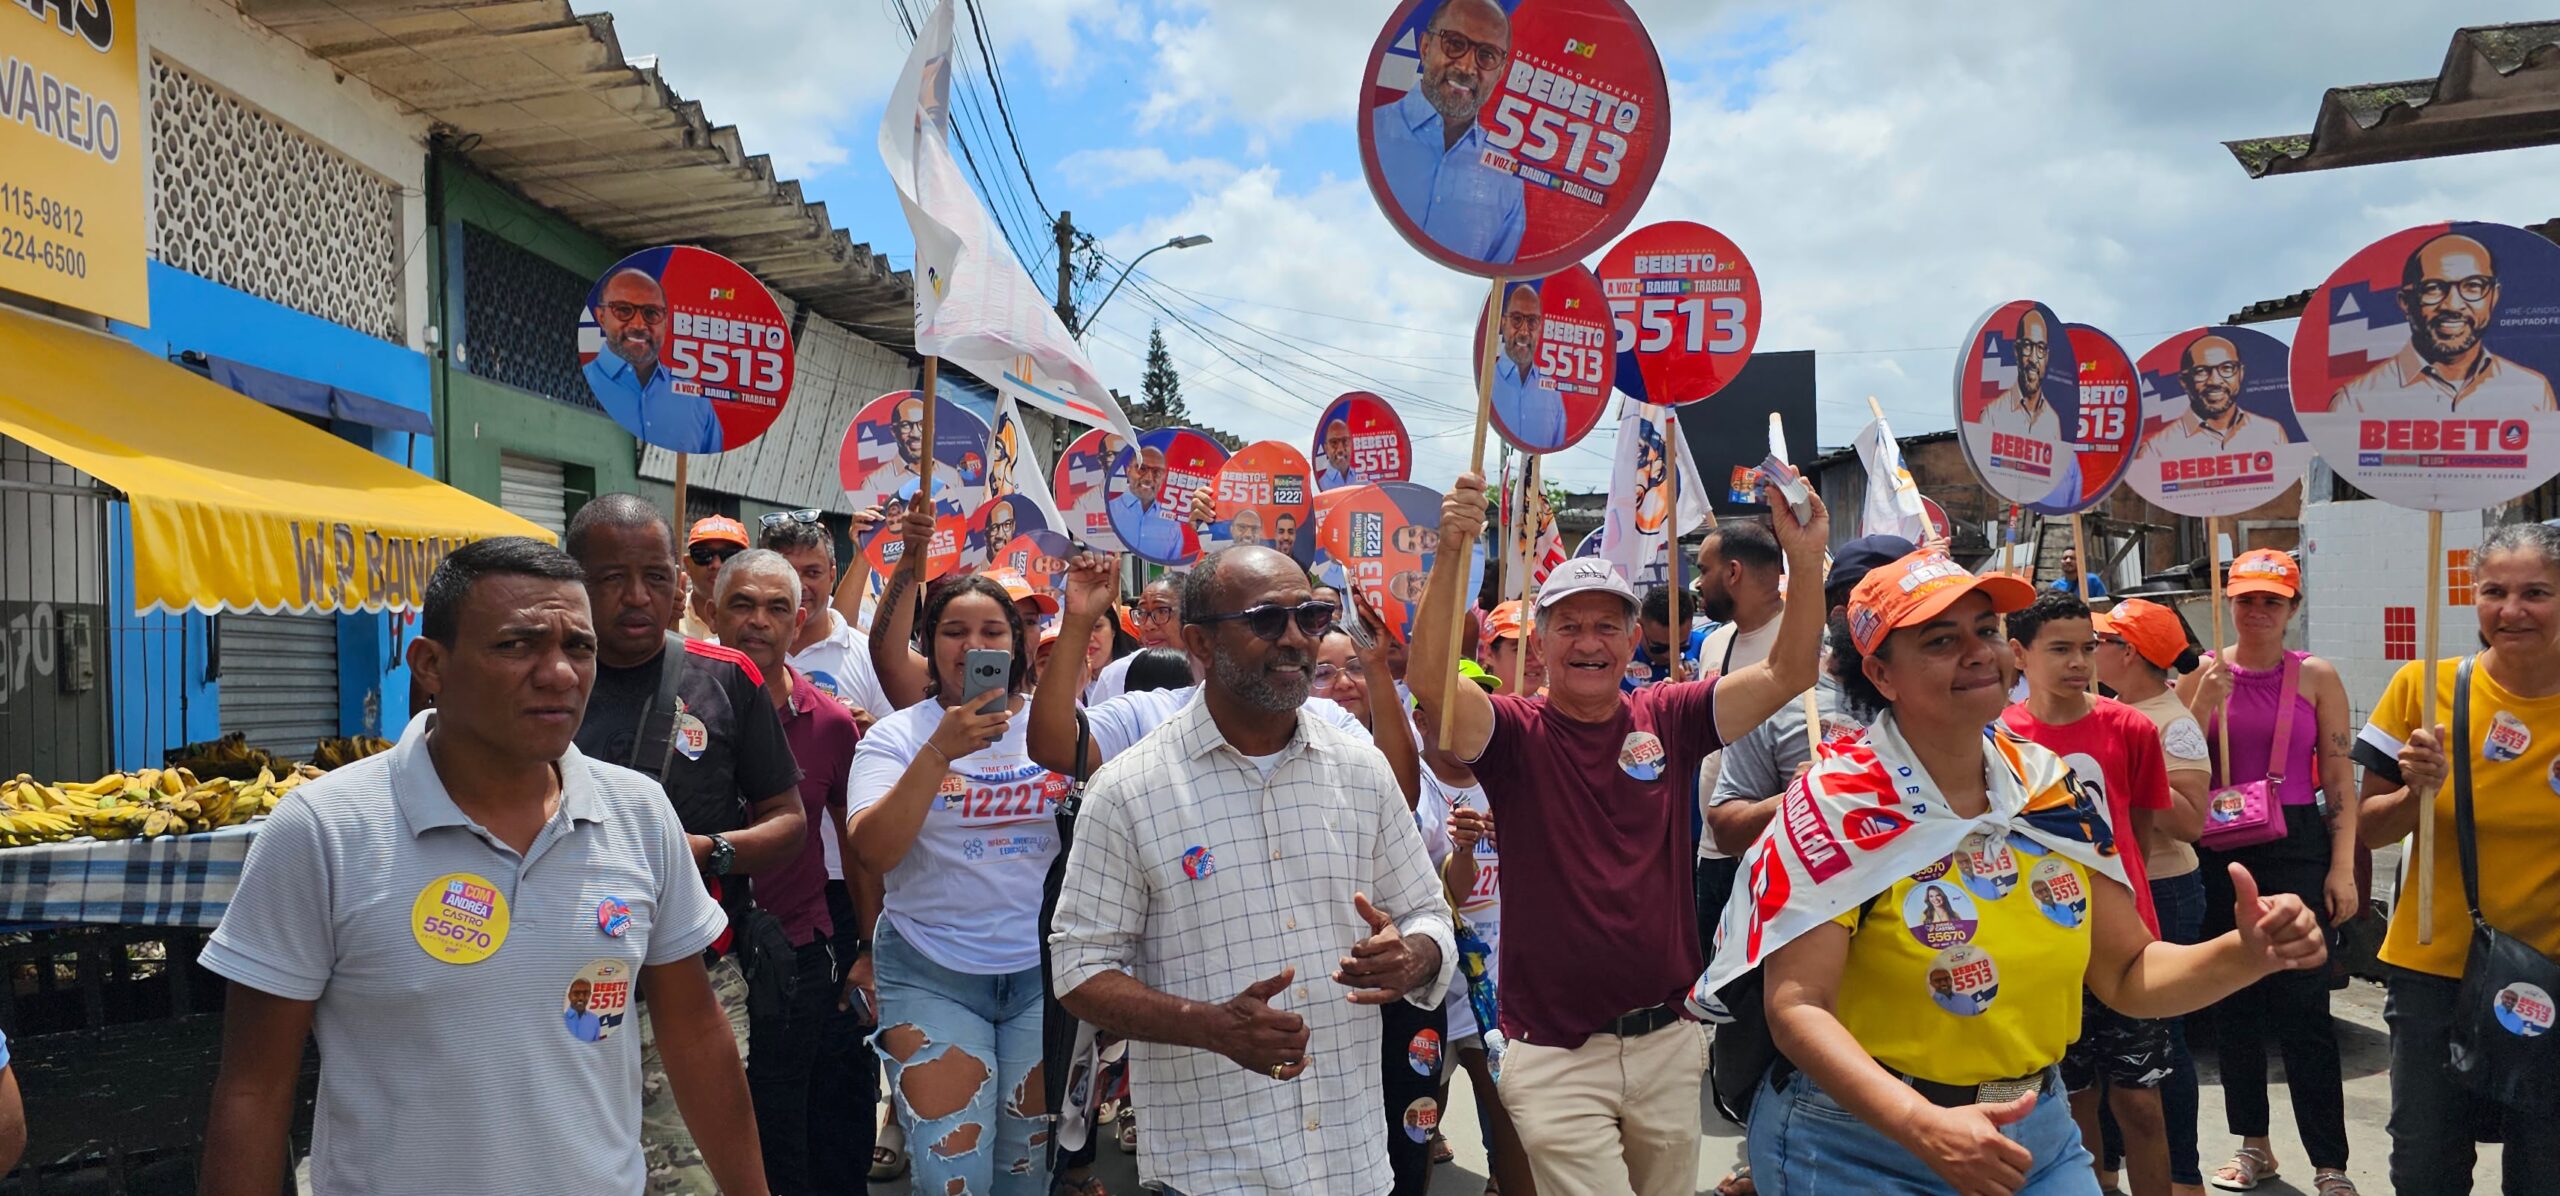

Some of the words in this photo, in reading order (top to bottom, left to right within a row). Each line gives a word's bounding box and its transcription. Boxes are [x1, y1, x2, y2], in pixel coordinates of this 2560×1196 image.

[1564, 38, 1597, 59] psd
[1516, 49, 1584, 80] DEPUTADO
[1590, 78, 1646, 104] FEDERAL
[1505, 59, 1641, 134] BEBETO
[0, 58, 119, 162] VAREJO
[1486, 94, 1628, 187] 5513
[1484, 152, 1493, 164] A
[1492, 154, 1510, 171] VOZ
[1518, 164, 1551, 186] BAHIA
[1561, 179, 1604, 206] TRABALHA
[1634, 254, 1716, 274] BEBETO
[1718, 261, 1735, 272] psd
[710, 288, 735, 300] psd
[1608, 282, 1614, 294] A
[1616, 282, 1633, 294] VOZ
[1646, 280, 1680, 294] BAHIA
[1694, 279, 1740, 292] TRABALHA
[1565, 298, 1580, 309] psd
[674, 304, 732, 318] DEPUTADO
[738, 314, 786, 326] FEDERAL
[2500, 317, 2547, 326] DEPUTADO
[673, 312, 785, 350] BEBETO
[1543, 320, 1605, 348] BEBETO
[1608, 297, 1747, 354] 5513
[671, 339, 784, 392] 5513
[1539, 342, 1603, 383] 5513
[2080, 360, 2096, 372] psd
[674, 384, 680, 392] A
[682, 384, 696, 394] VOZ
[704, 387, 730, 400] BAHIA
[742, 392, 776, 406] TRABALHA
[2080, 385, 2128, 404] BETO
[2076, 407, 2126, 440] 513
[1353, 434, 1398, 450] BEBETO
[2360, 419, 2529, 450] BEBETO
[1992, 432, 2053, 465] BEBETO
[1355, 448, 1400, 473] 5513
[2160, 450, 2273, 482] BEBETO
[1222, 472, 1260, 483] BEBETO
[1160, 486, 1193, 513] 55
[1218, 480, 1271, 505] 5513
[1274, 491, 1302, 503] 12227
[929, 530, 954, 547] 55
[1367, 513, 1381, 557] 12227
[688, 736, 702, 746] 13
[2491, 730, 2525, 750] 5513
[2496, 725, 2527, 741] BEBETO
[1634, 744, 1661, 762] 5513
[942, 782, 962, 793] 513
[962, 782, 1045, 818] 12227
[2048, 873, 2075, 887] BEBETO
[464, 884, 490, 901] COM
[2052, 882, 2080, 901] 5513
[447, 894, 488, 917] ANDRÉA
[442, 908, 484, 928] CASTRO
[424, 916, 490, 948] 55670
[1927, 931, 1966, 942] 55670
[1952, 958, 1989, 976] BEBETO
[592, 981, 628, 992] BEBETO
[1954, 968, 1993, 992] 5513
[590, 992, 626, 1009] 5513
[2516, 1004, 2550, 1023] 5513
[1418, 1116, 1437, 1126] 5513
